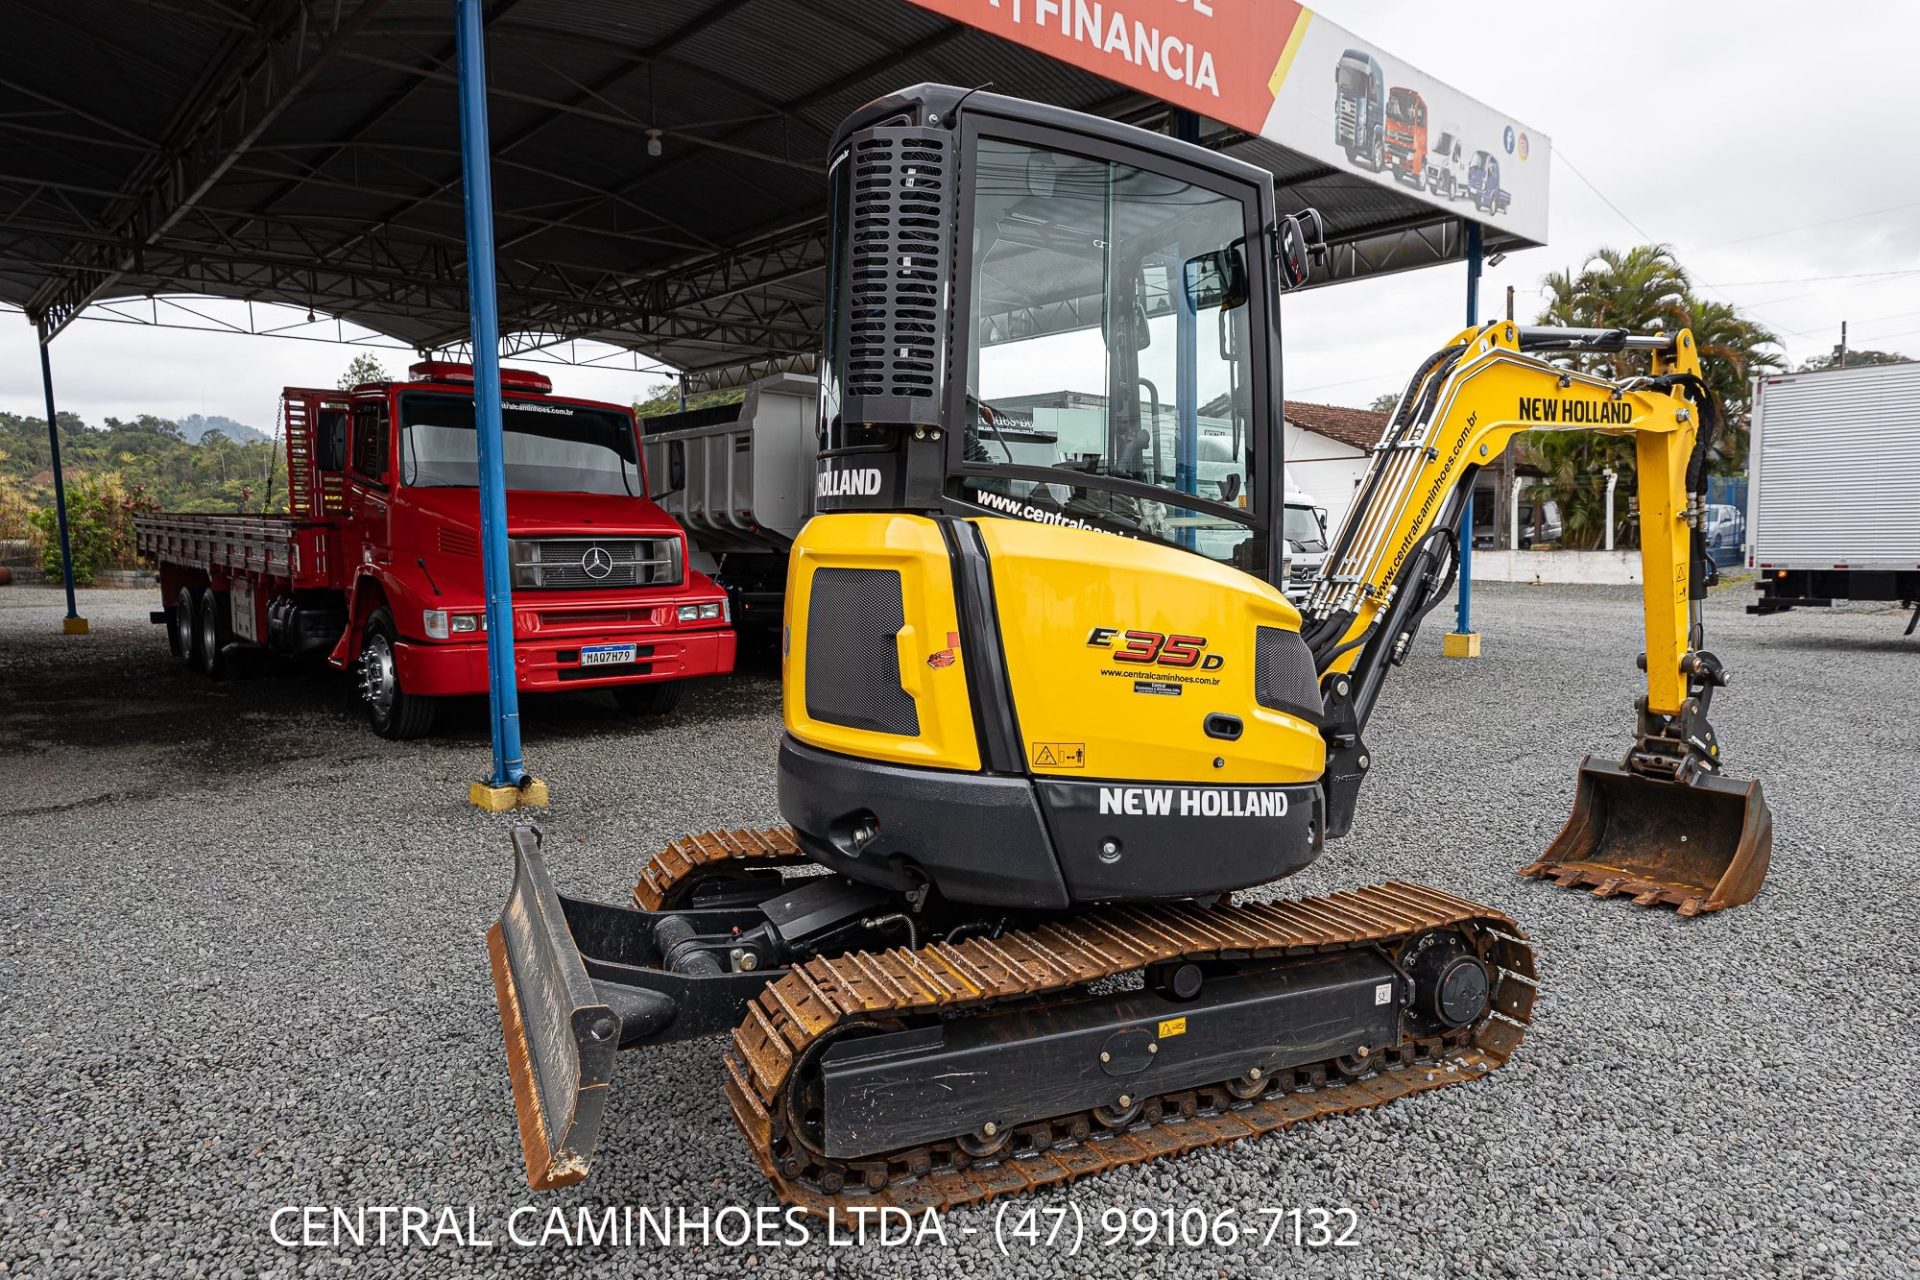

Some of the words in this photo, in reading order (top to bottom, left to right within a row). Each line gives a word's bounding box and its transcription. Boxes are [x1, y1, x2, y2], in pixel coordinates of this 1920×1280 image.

[1519, 397, 1558, 422] NEW
[1562, 399, 1633, 424] HOLLAND
[818, 468, 882, 497] HOLLAND
[1375, 410, 1479, 599] www.centralcaminhoes.com.br
[586, 651, 630, 664] MAQ7H79
[1100, 669, 1221, 686] www.centralcaminhoes.com.br
[1100, 788, 1173, 815] NEW
[1180, 790, 1289, 817] HOLLAND
